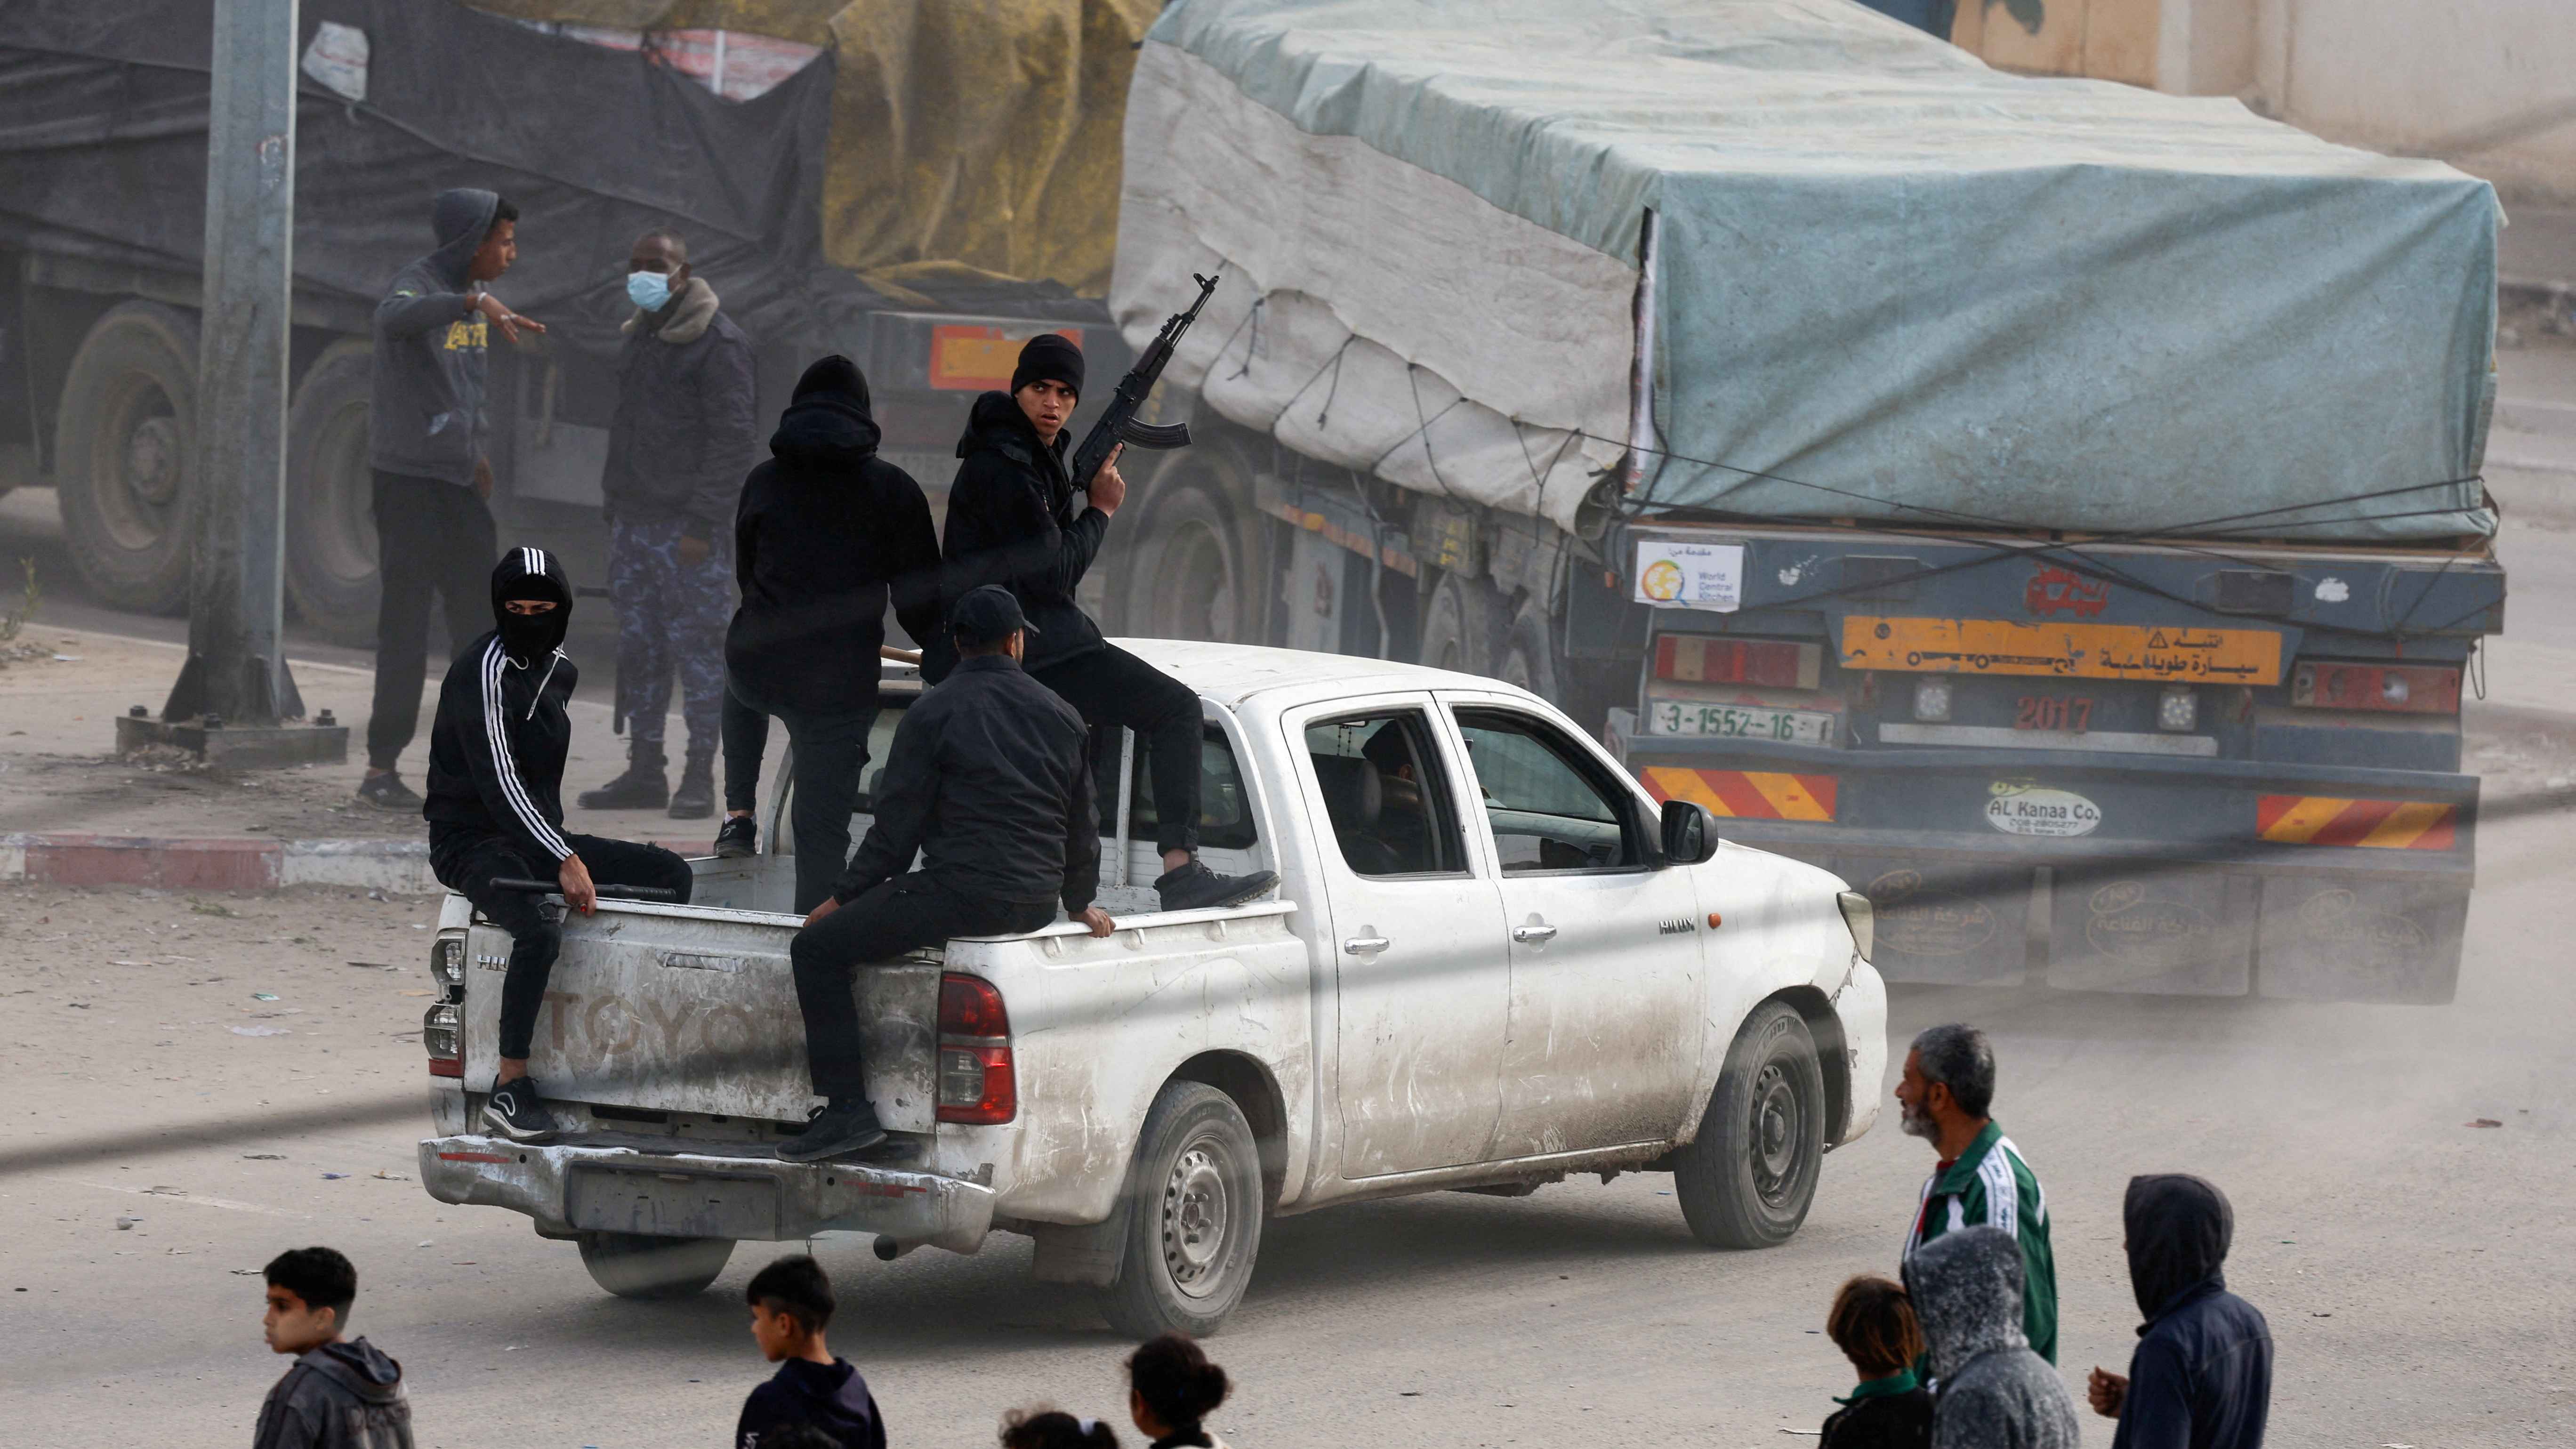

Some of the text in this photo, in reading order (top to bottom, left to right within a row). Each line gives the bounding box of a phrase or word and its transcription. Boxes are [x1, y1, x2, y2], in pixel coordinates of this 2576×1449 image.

[1698, 572, 1726, 581] World
[1699, 582, 1733, 591] Central
[1699, 592, 1734, 602] Kitchen
[2014, 696, 2094, 733] 2017
[2018, 801, 2067, 819] Kanaa
[2073, 804, 2099, 821] Co.
[1659, 918, 1695, 935] HILUX
[477, 955, 508, 972] HIL
